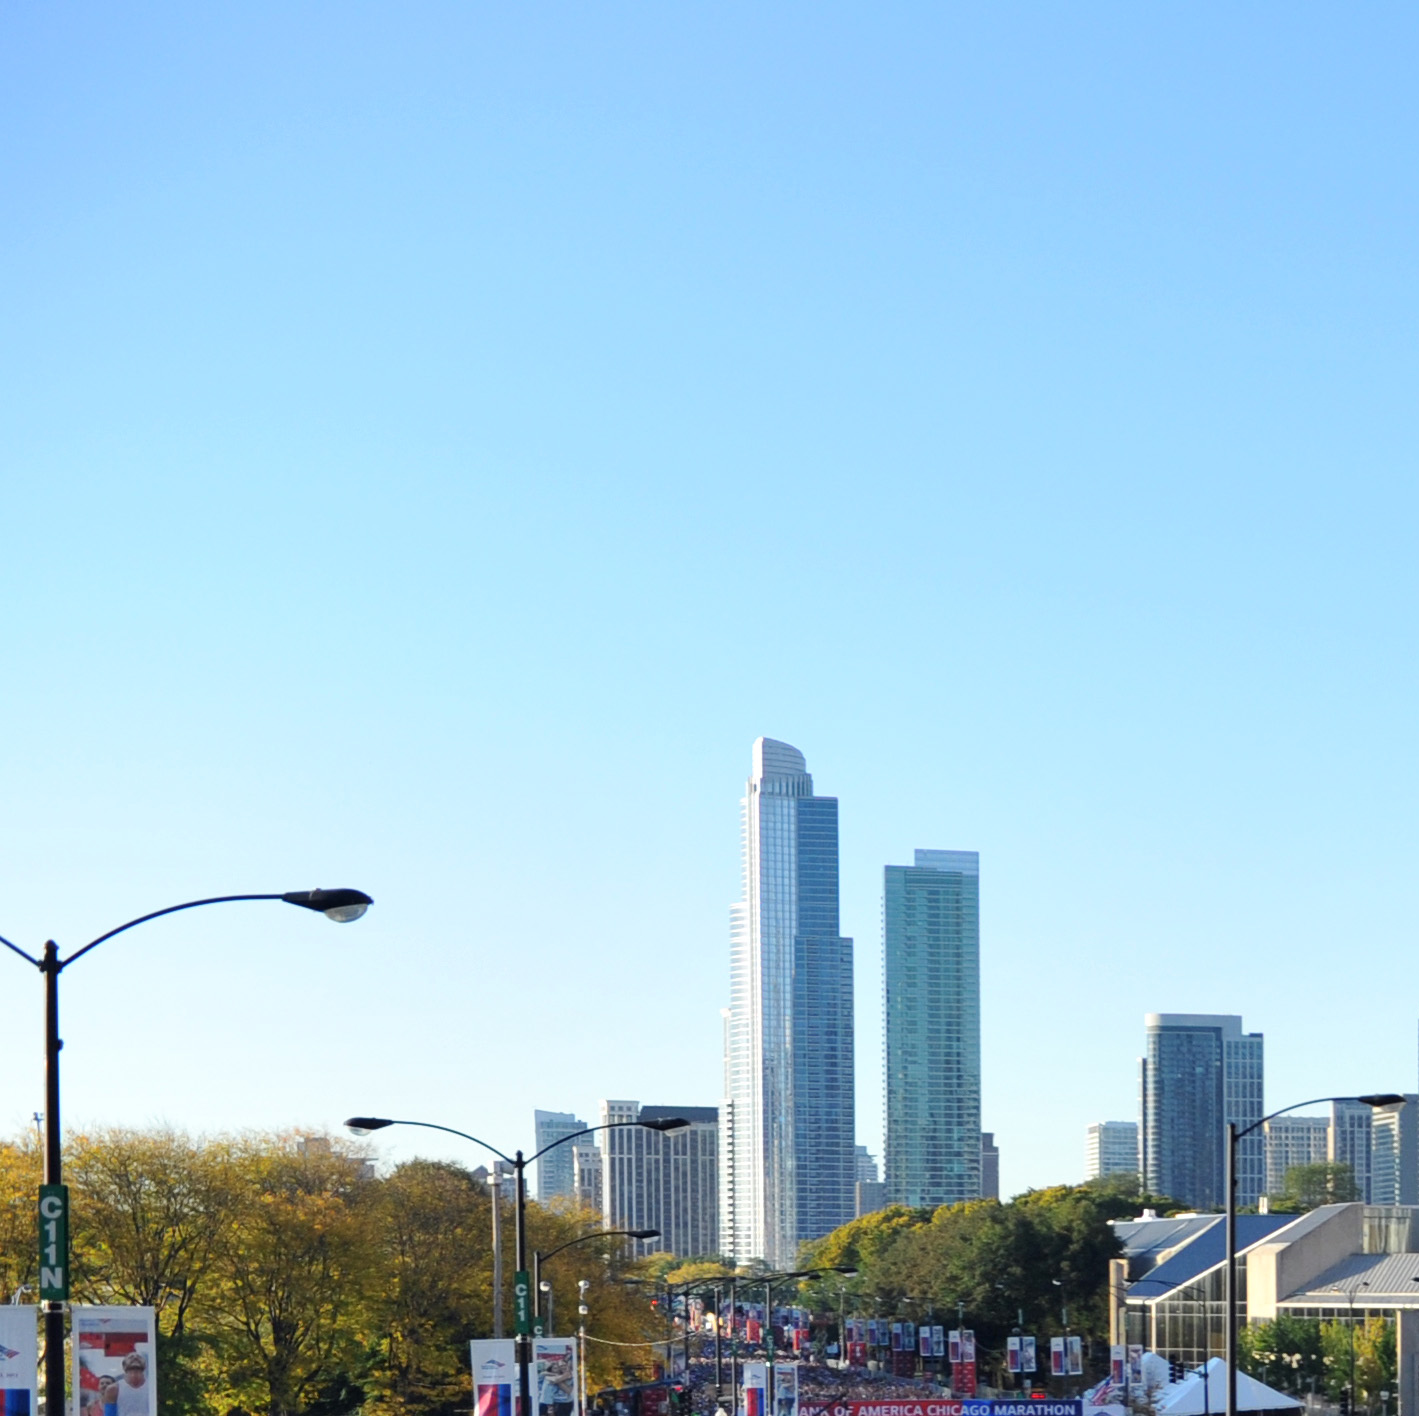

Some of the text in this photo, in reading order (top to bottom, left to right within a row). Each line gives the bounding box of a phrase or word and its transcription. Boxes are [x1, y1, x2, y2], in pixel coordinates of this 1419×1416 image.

[40, 1196, 62, 1289] C11N
[515, 1284, 527, 1321] C11
[835, 1403, 853, 1416] OF
[858, 1402, 922, 1416] AMERICA
[927, 1403, 989, 1416] CHICAGO
[994, 1403, 1076, 1416] MARATHON
